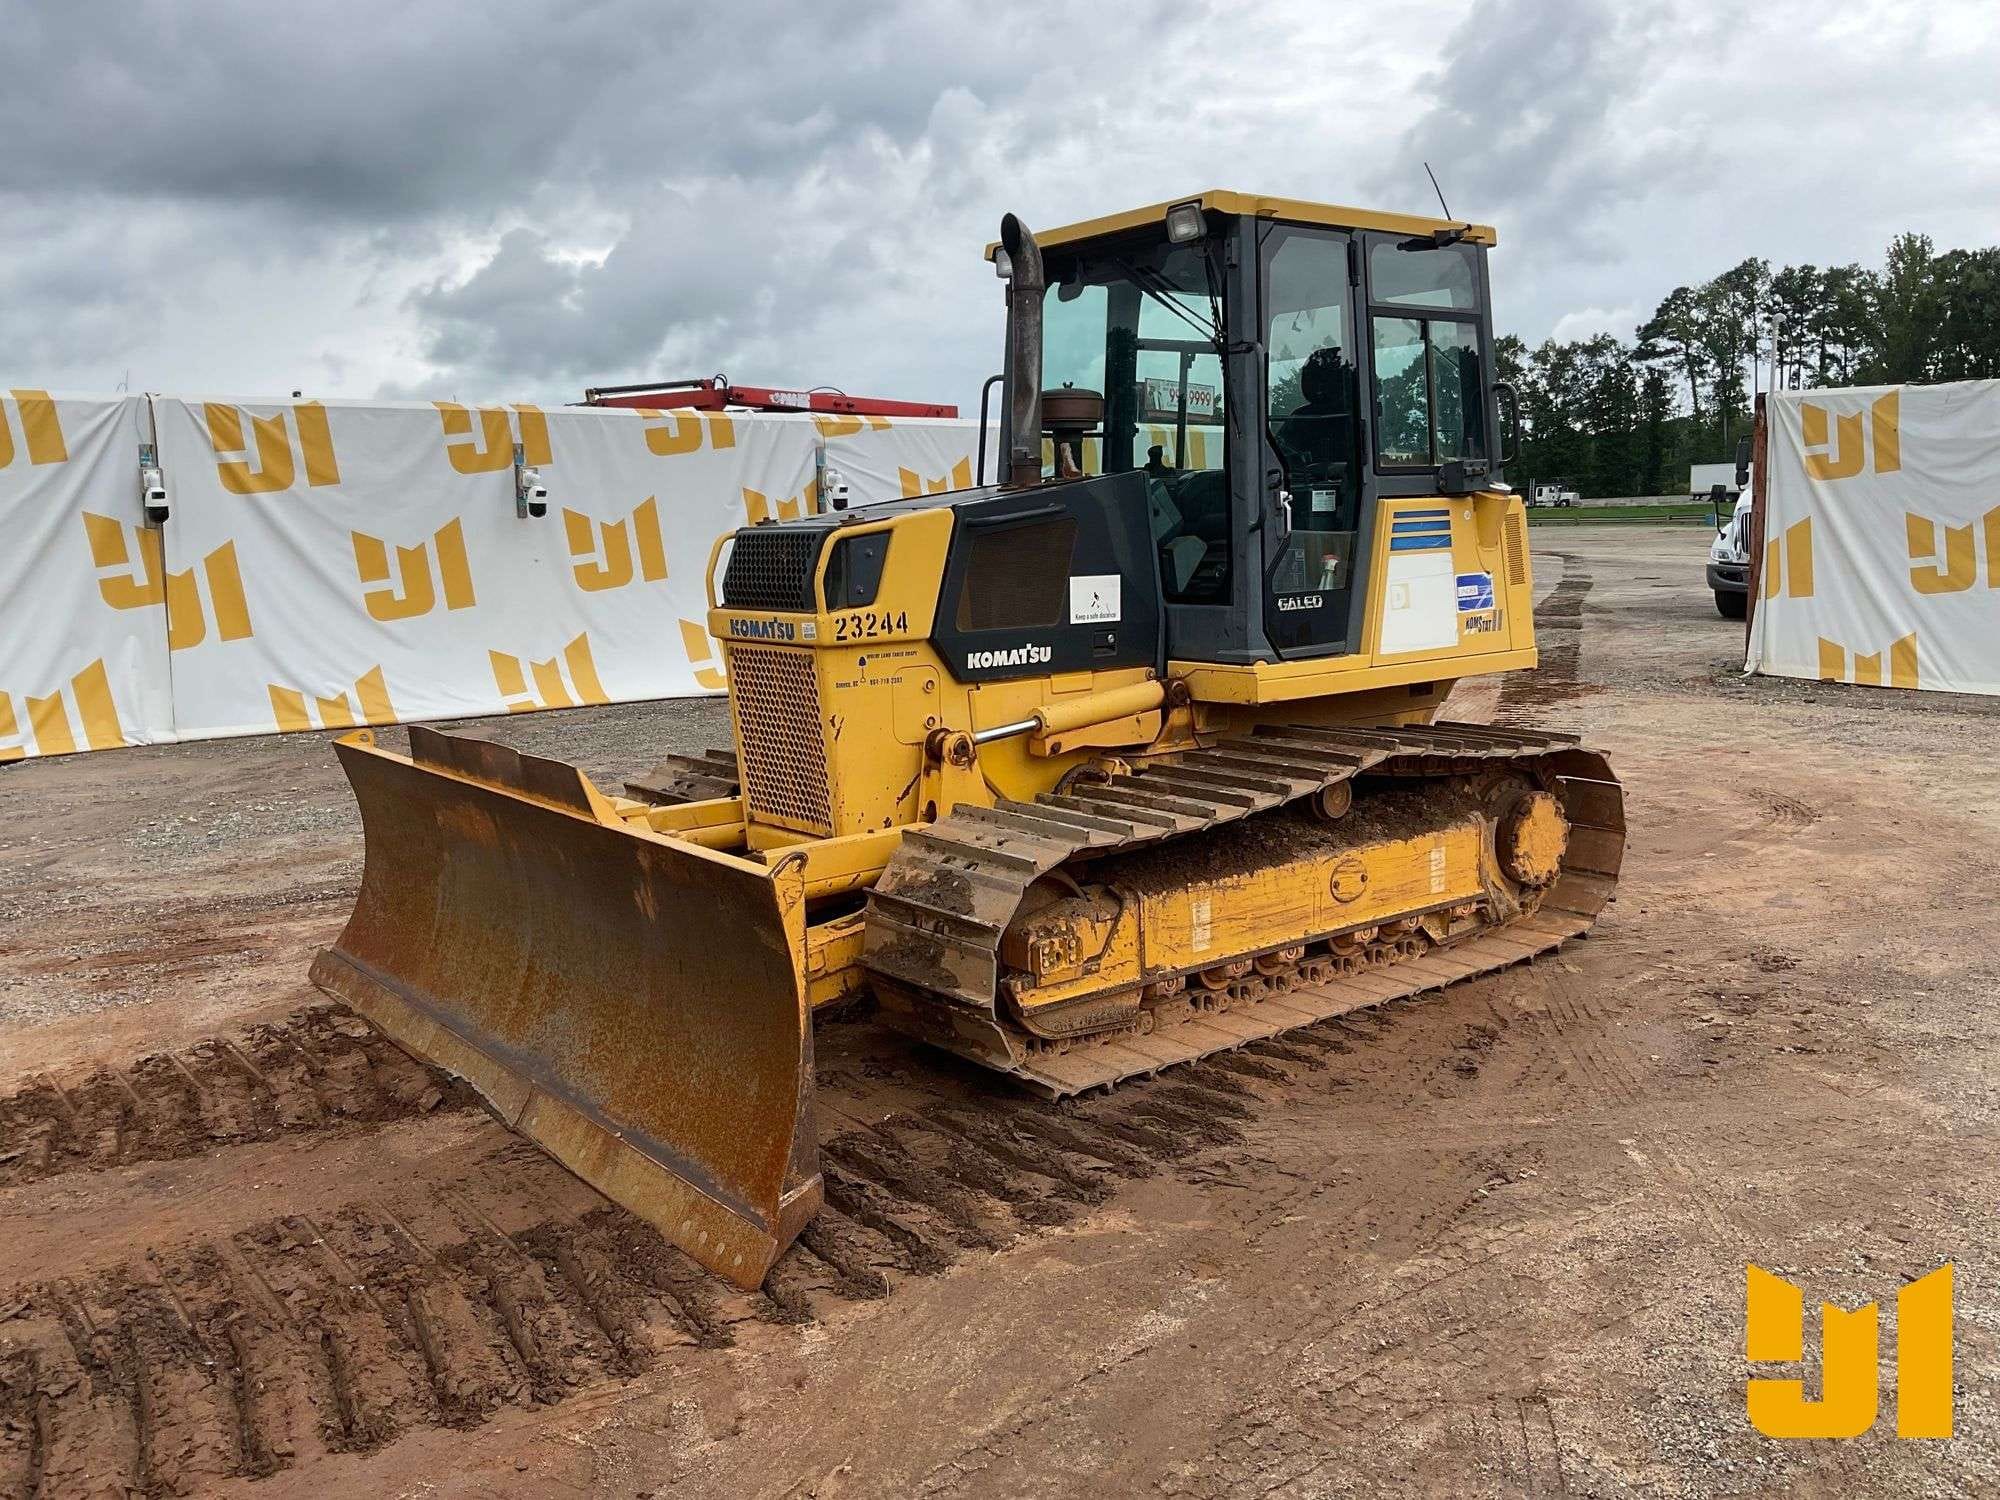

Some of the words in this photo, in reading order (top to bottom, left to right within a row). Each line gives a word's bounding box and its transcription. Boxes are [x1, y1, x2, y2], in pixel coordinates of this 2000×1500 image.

[1278, 595, 1322, 611] GALEO
[729, 616, 795, 641] KOMATSU
[835, 611, 909, 641] 23244
[967, 643, 1052, 669] KOMATSU
